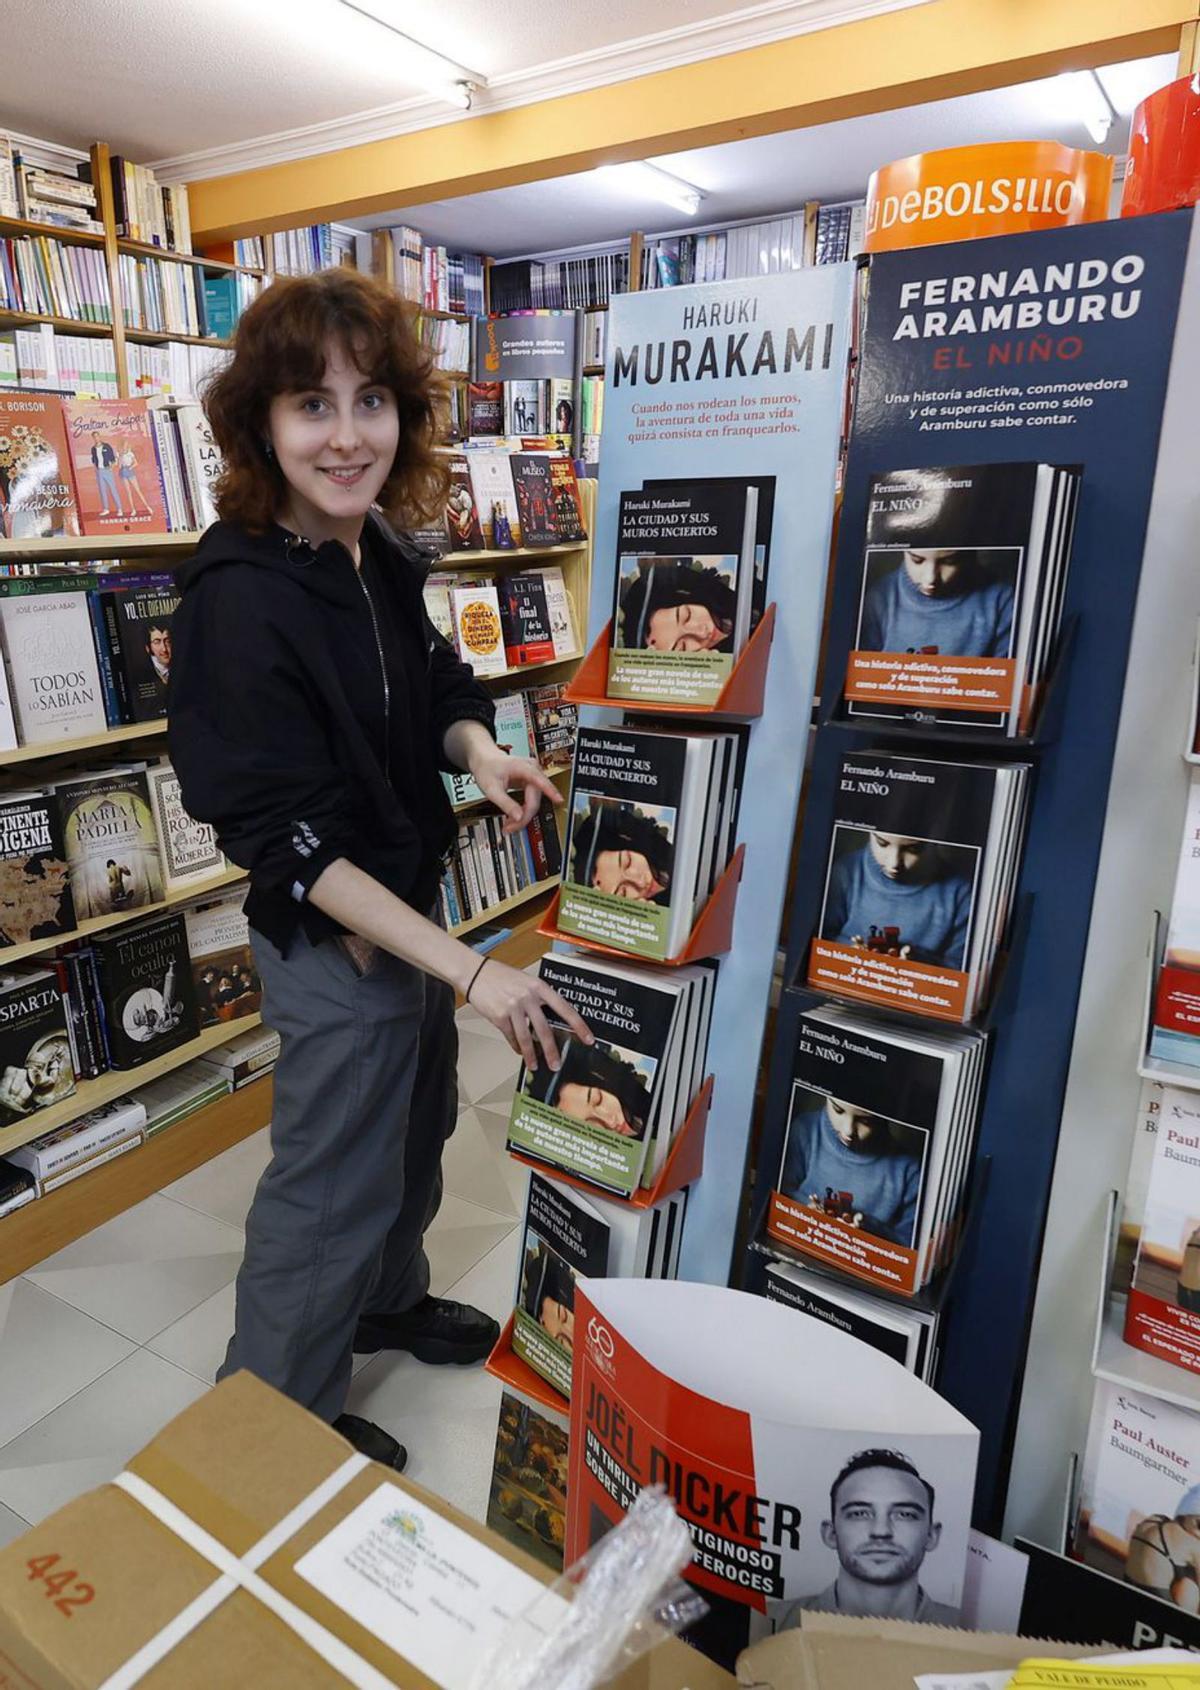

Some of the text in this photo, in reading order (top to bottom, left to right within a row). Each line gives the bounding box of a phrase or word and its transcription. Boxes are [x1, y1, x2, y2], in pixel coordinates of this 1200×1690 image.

[900, 255, 1145, 309] FERNANDO
[683, 298, 758, 330] HARUKI
[893, 289, 1142, 341] ARAMBURU
[613, 323, 834, 388] MURAKAMI
[933, 333, 1083, 371] EL NIÑO
[885, 378, 1129, 404] Una historia adictiva, conmovedora
[632, 394, 801, 415] Cuando nos rodean los muros,
[909, 396, 1093, 420] y de superación como sólo
[636, 407, 794, 428] la aventura de toda una vida
[919, 411, 1077, 432] Aramburu sabe contar.
[628, 422, 800, 445] quizá consista en franquearlos.
[199, 448, 217, 460] LA
[522, 467, 546, 476] MUSEO
[873, 482, 918, 495] Fernando
[624, 499, 691, 510] Haruki Murakami
[871, 497, 922, 513] EL NIÑO
[623, 513, 710, 526] LA CIUDAD Y SUS
[622, 526, 718, 538] MUROS INCIERTOS
[519, 606, 538, 619] final
[524, 630, 549, 641] historia
[30, 671, 86, 695] TODOS
[29, 687, 95, 711] LO SABÍAN
[580, 738, 635, 753] Haruki Murakami
[578, 752, 651, 771] LA CIUDAD Y SUS
[842, 763, 935, 784] Fernando Aramburu
[577, 764, 658, 785] MUROS INCIERTOS
[840, 779, 889, 796] EL NIÑO
[0, 826, 52, 852] ÍGENA
[197, 826, 212, 845] 21
[138, 931, 180, 957] canon
[131, 953, 175, 978] oculto
[543, 968, 617, 997] Haruki Murakami
[558, 987, 634, 1018] CIUDAD Y SUS
[581, 1006, 640, 1033] INCIERTOS
[799, 1040, 845, 1066] EL NIÑO
[801, 1024, 887, 1062] Fernando Aramburu
[553, 1127, 571, 1140] gran
[1167, 1129, 1200, 1149] Paul
[540, 1200, 564, 1227] CIUDAD
[552, 1222, 588, 1258] INCIERTOS
[767, 1279, 852, 1331] Fernando Aramburu
[1114, 1419, 1191, 1469] Paul Auster
[586, 1381, 802, 1551] JOËL DICKER
[587, 1429, 639, 1497] UN THRILL
[1110, 1435, 1188, 1486] Baumgartner
[585, 1451, 618, 1500] SOBRE
[681, 1518, 774, 1571] TIGINOSO
[692, 1550, 774, 1594] FEROCES
[26, 1552, 96, 1617] 442
[1075, 1676, 1092, 1684] DE
[1095, 1677, 1148, 1688] PEDIDO
